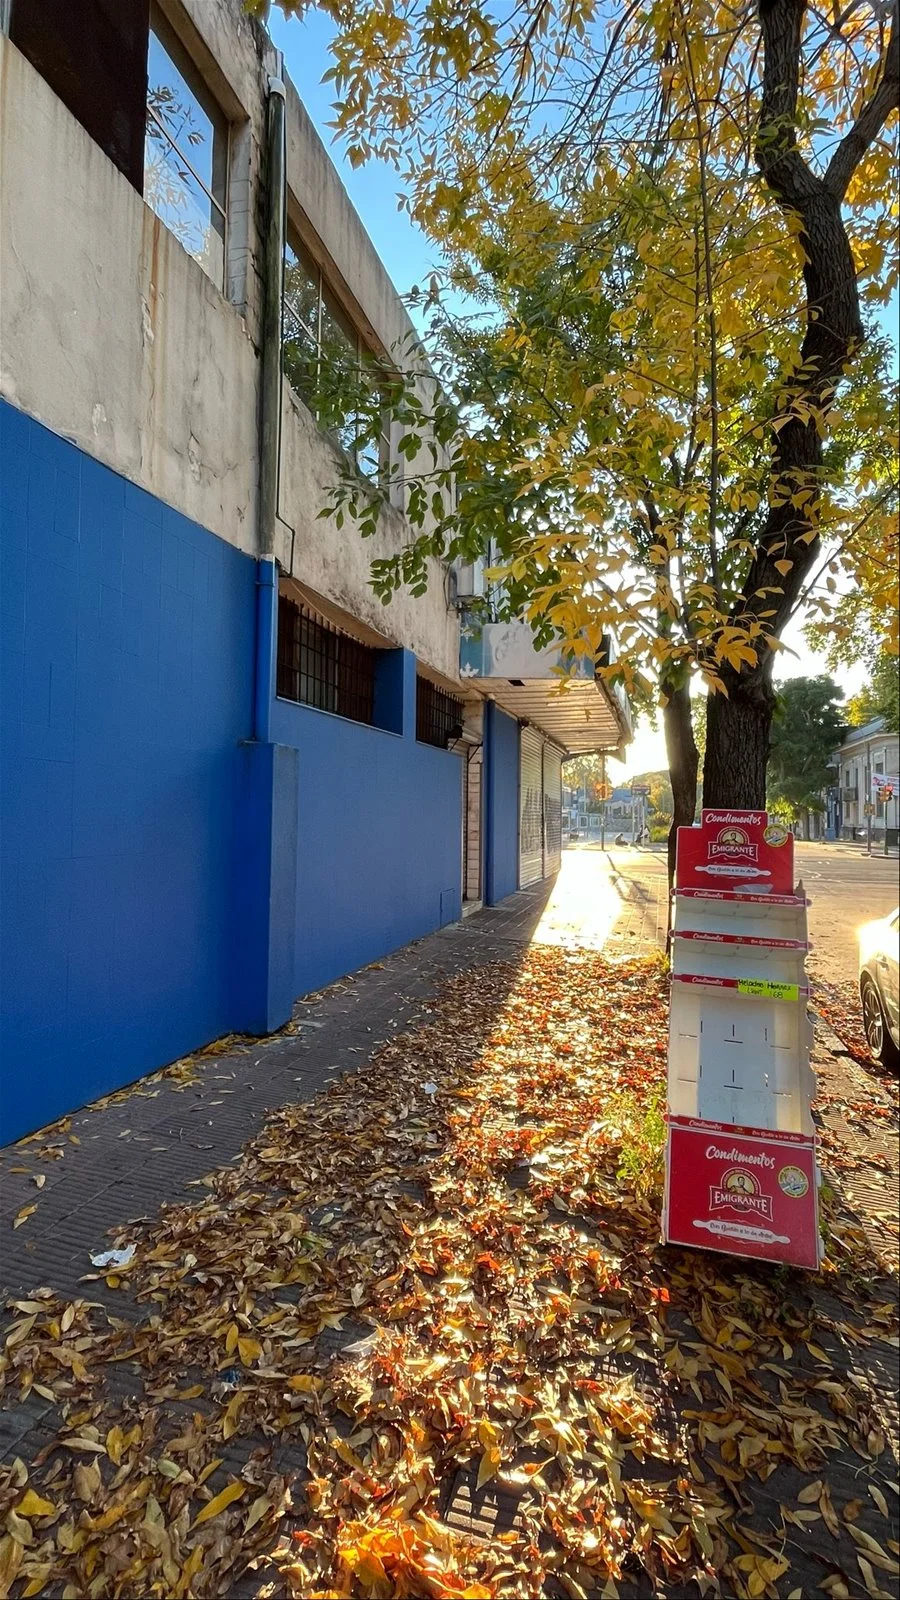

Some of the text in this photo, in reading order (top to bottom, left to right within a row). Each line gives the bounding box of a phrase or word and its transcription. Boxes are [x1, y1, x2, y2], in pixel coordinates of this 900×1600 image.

[705, 812, 762, 825] Condimentos
[712, 845, 755, 857] EMIGRANTE
[688, 1119, 723, 1131] Condimentos
[705, 1145, 776, 1169] Condimentos
[714, 1191, 768, 1213] EMIGRANTE
